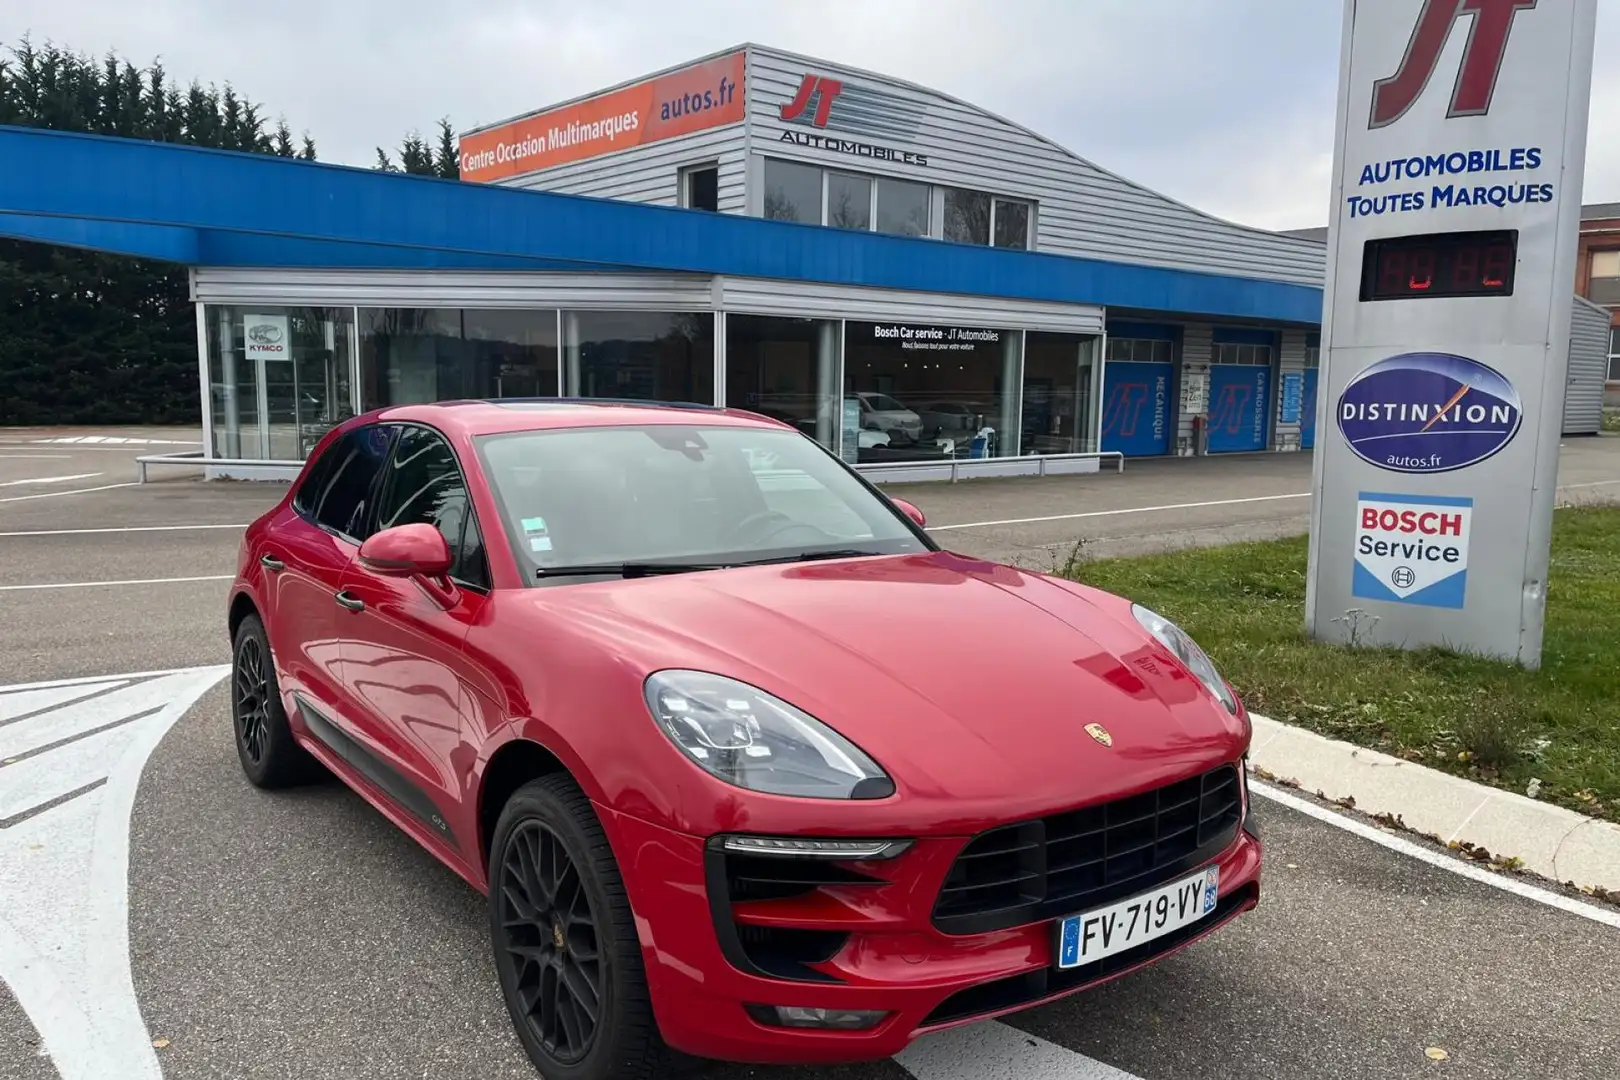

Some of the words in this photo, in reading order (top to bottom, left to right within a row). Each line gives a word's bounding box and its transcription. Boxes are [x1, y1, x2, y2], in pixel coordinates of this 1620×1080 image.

[660, 76, 736, 121] autos.fr
[779, 72, 844, 129] JT
[461, 150, 495, 173] Centre
[496, 134, 546, 163] Occasion
[548, 110, 639, 150] Multimarques
[780, 130, 928, 167] AUTOMOBILES
[1359, 147, 1542, 186] AUTOMOBILES
[1347, 191, 1425, 218] TOUTES
[1430, 183, 1554, 209] MARQUES
[249, 344, 283, 352] KYMCO
[874, 325, 900, 338] Bosch
[900, 326, 914, 338] Car
[915, 327, 943, 339] service
[947, 328, 957, 340] JT
[957, 329, 999, 341] Automobiles
[1153, 376, 1165, 441] MECANIQUE
[1253, 372, 1265, 443] CARROSSERIE
[1386, 453, 1442, 468] autos.fr
[1361, 507, 1463, 537] BOSCH
[1358, 534, 1460, 563] Service
[1204, 890, 1216, 908] 68
[1081, 879, 1204, 956] FV-719-VY
[1067, 945, 1073, 957] F
